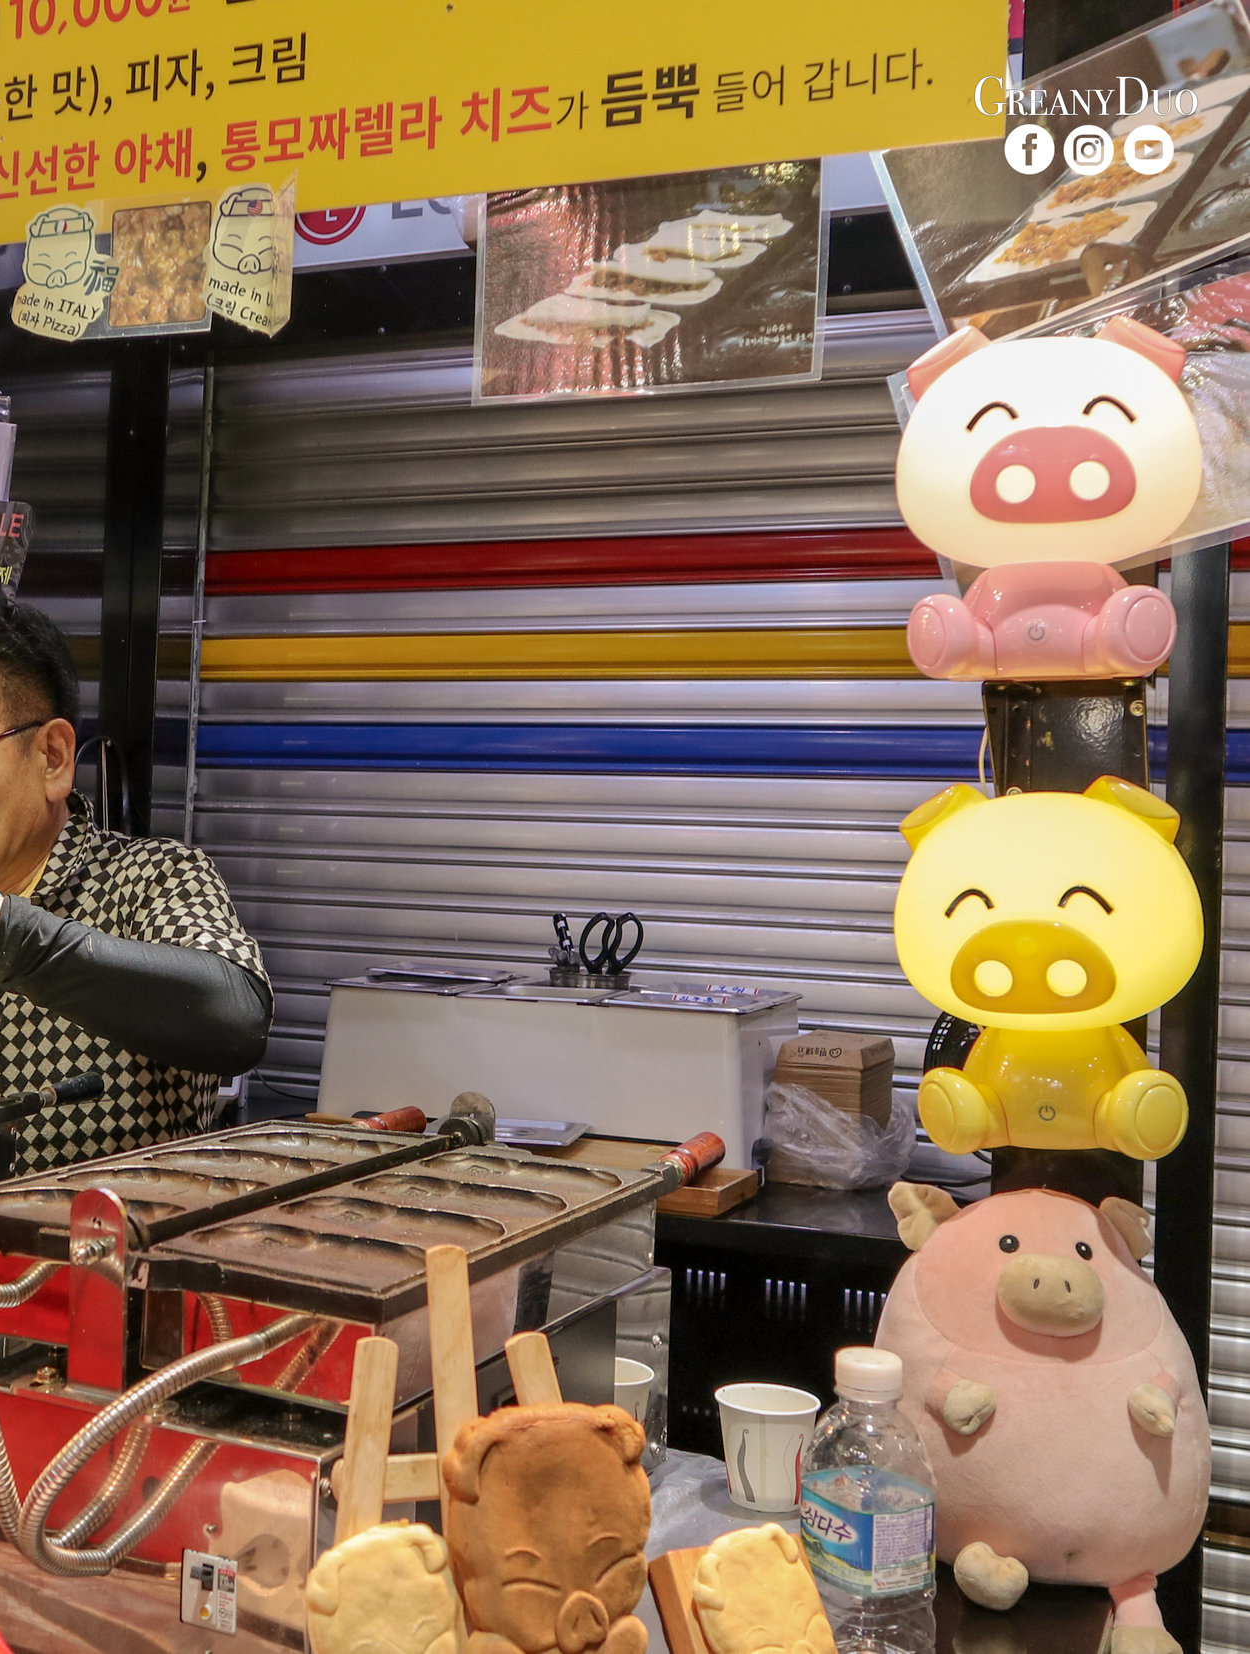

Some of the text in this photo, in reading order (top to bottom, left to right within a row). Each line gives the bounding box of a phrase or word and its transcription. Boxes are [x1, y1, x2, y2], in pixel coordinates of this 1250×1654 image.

[52, 64, 113, 116] 맛),
[127, 47, 216, 102] 피자,
[228, 31, 308, 88] 크림
[114, 127, 208, 184] 야채,
[221, 96, 442, 172] 통모짜렐라
[460, 86, 588, 144] 치즈가
[601, 61, 701, 129] 듬뿍
[712, 58, 787, 115] 들어
[802, 47, 934, 109] 갑니다.
[208, 277, 247, 297] made
[250, 287, 262, 304] in
[43, 297, 54, 311] in
[57, 298, 100, 320] ITALY
[43, 315, 81, 337] Pizza)
[804, 1505, 853, 1543] 삼다수
